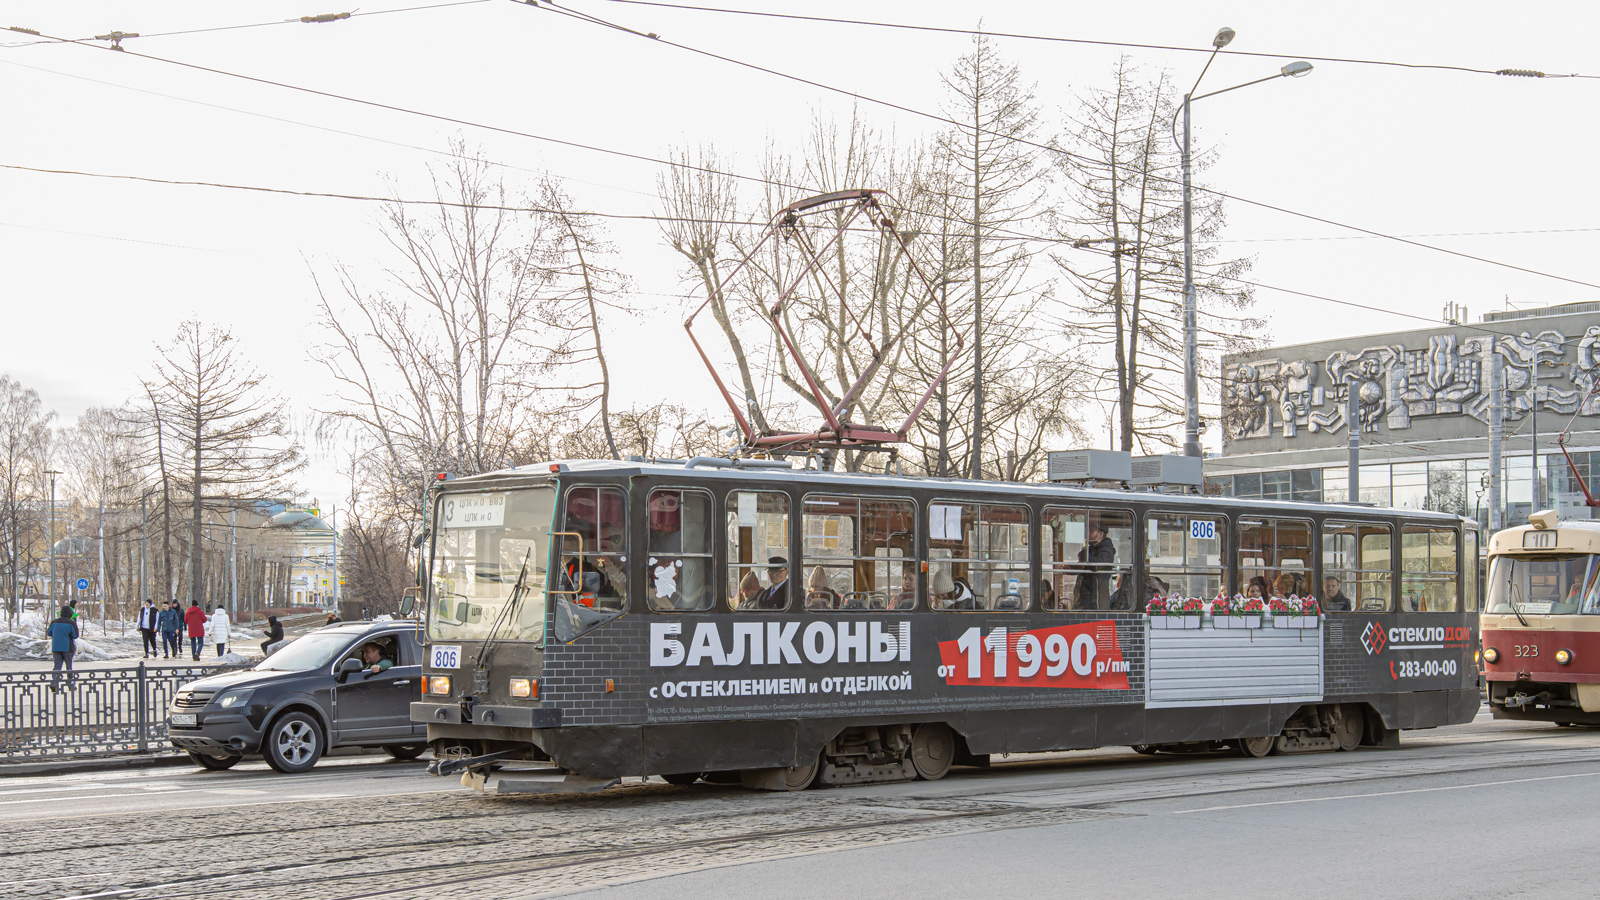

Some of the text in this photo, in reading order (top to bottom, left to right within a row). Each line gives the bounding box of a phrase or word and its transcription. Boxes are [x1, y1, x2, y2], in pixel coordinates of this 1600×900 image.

[446, 500, 454, 522] 3
[1192, 521, 1213, 538] 806
[1532, 533, 1549, 547] 10
[649, 621, 911, 667] БАЛКОНЫ
[1514, 644, 1540, 658] 323
[435, 650, 457, 668] 806
[937, 665, 956, 678] от
[1399, 659, 1457, 678] 283-00-00
[649, 671, 912, 698] с ОСТЕКЛЕНИЕМ и ОТДЕЛКОЙ
